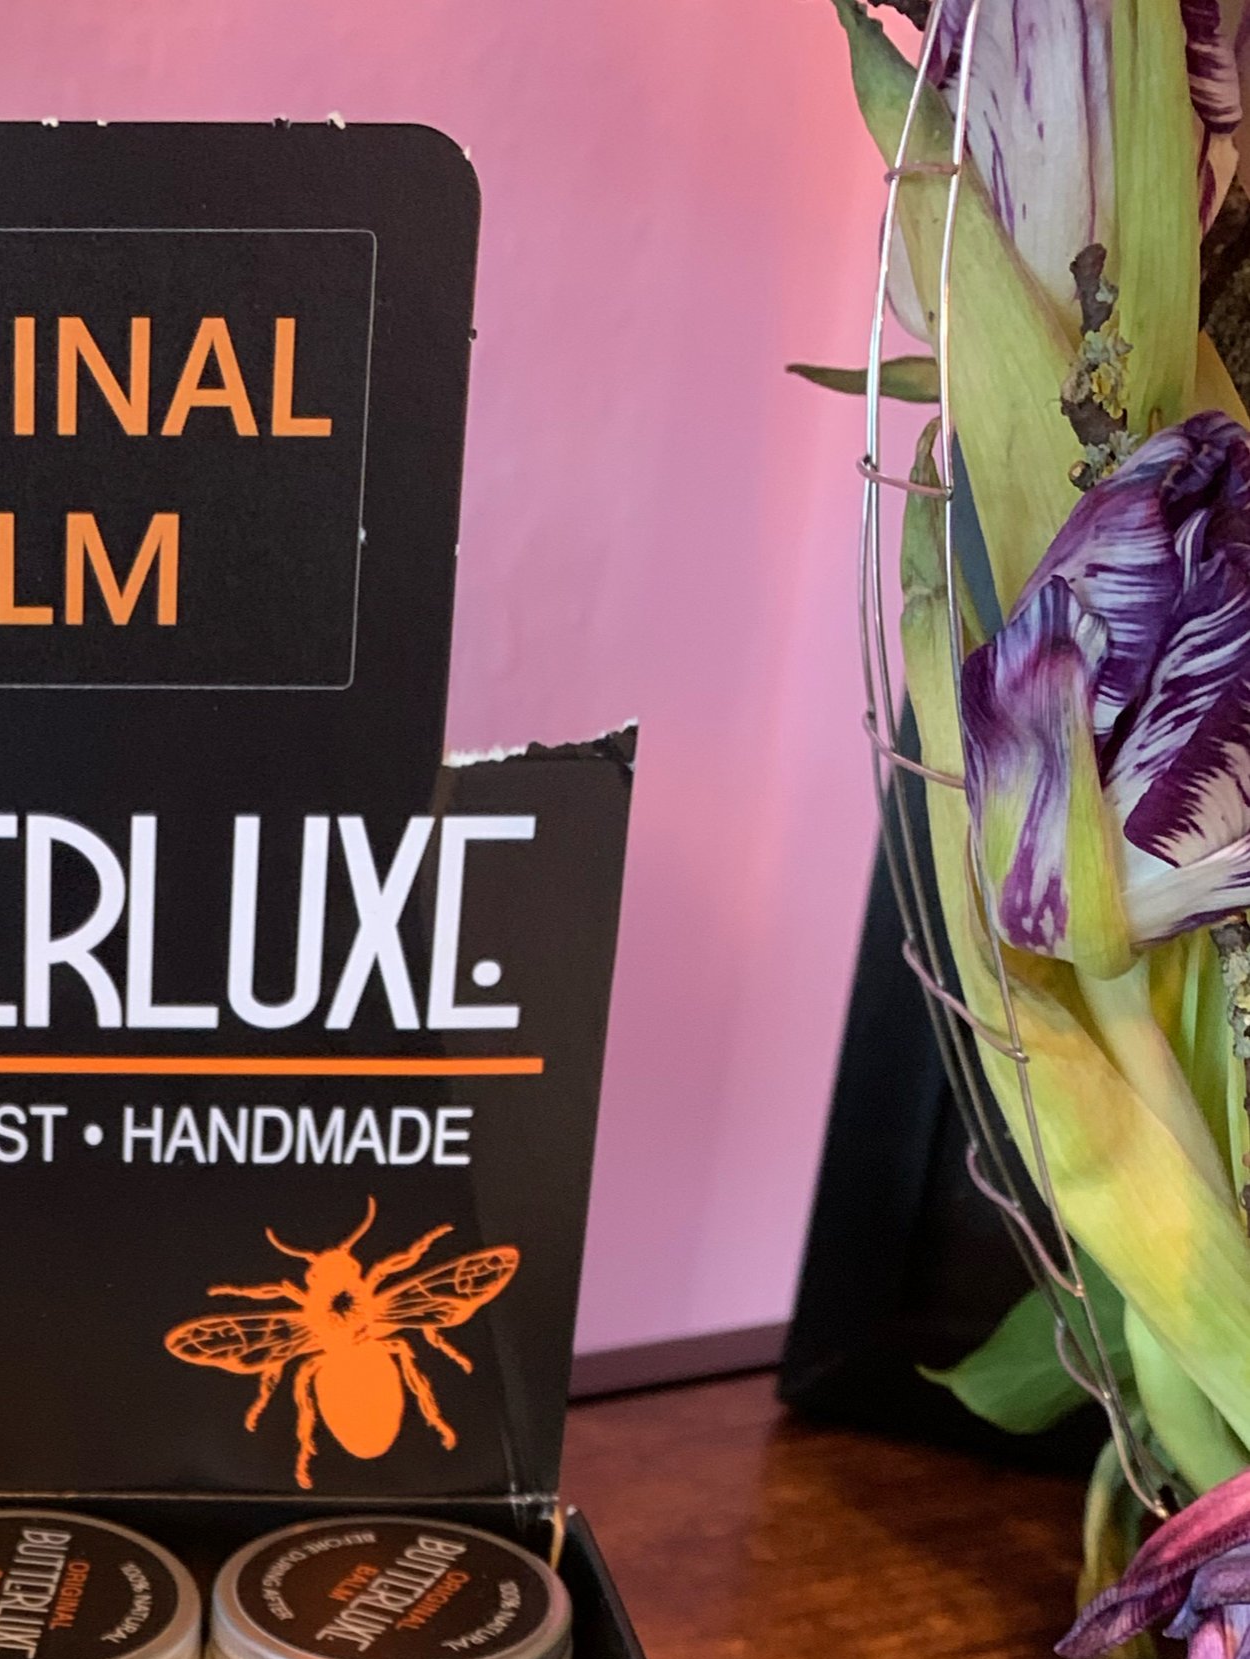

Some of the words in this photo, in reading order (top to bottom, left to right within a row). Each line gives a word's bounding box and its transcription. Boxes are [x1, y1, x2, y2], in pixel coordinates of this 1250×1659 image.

[121, 1106, 474, 1165] HANDMADE
[50, 1560, 90, 1629] ORIGINAL
[316, 1535, 467, 1651] BUTTERLUXE
[328, 1563, 380, 1600] BALM
[396, 1570, 471, 1629] ORIGINAL
